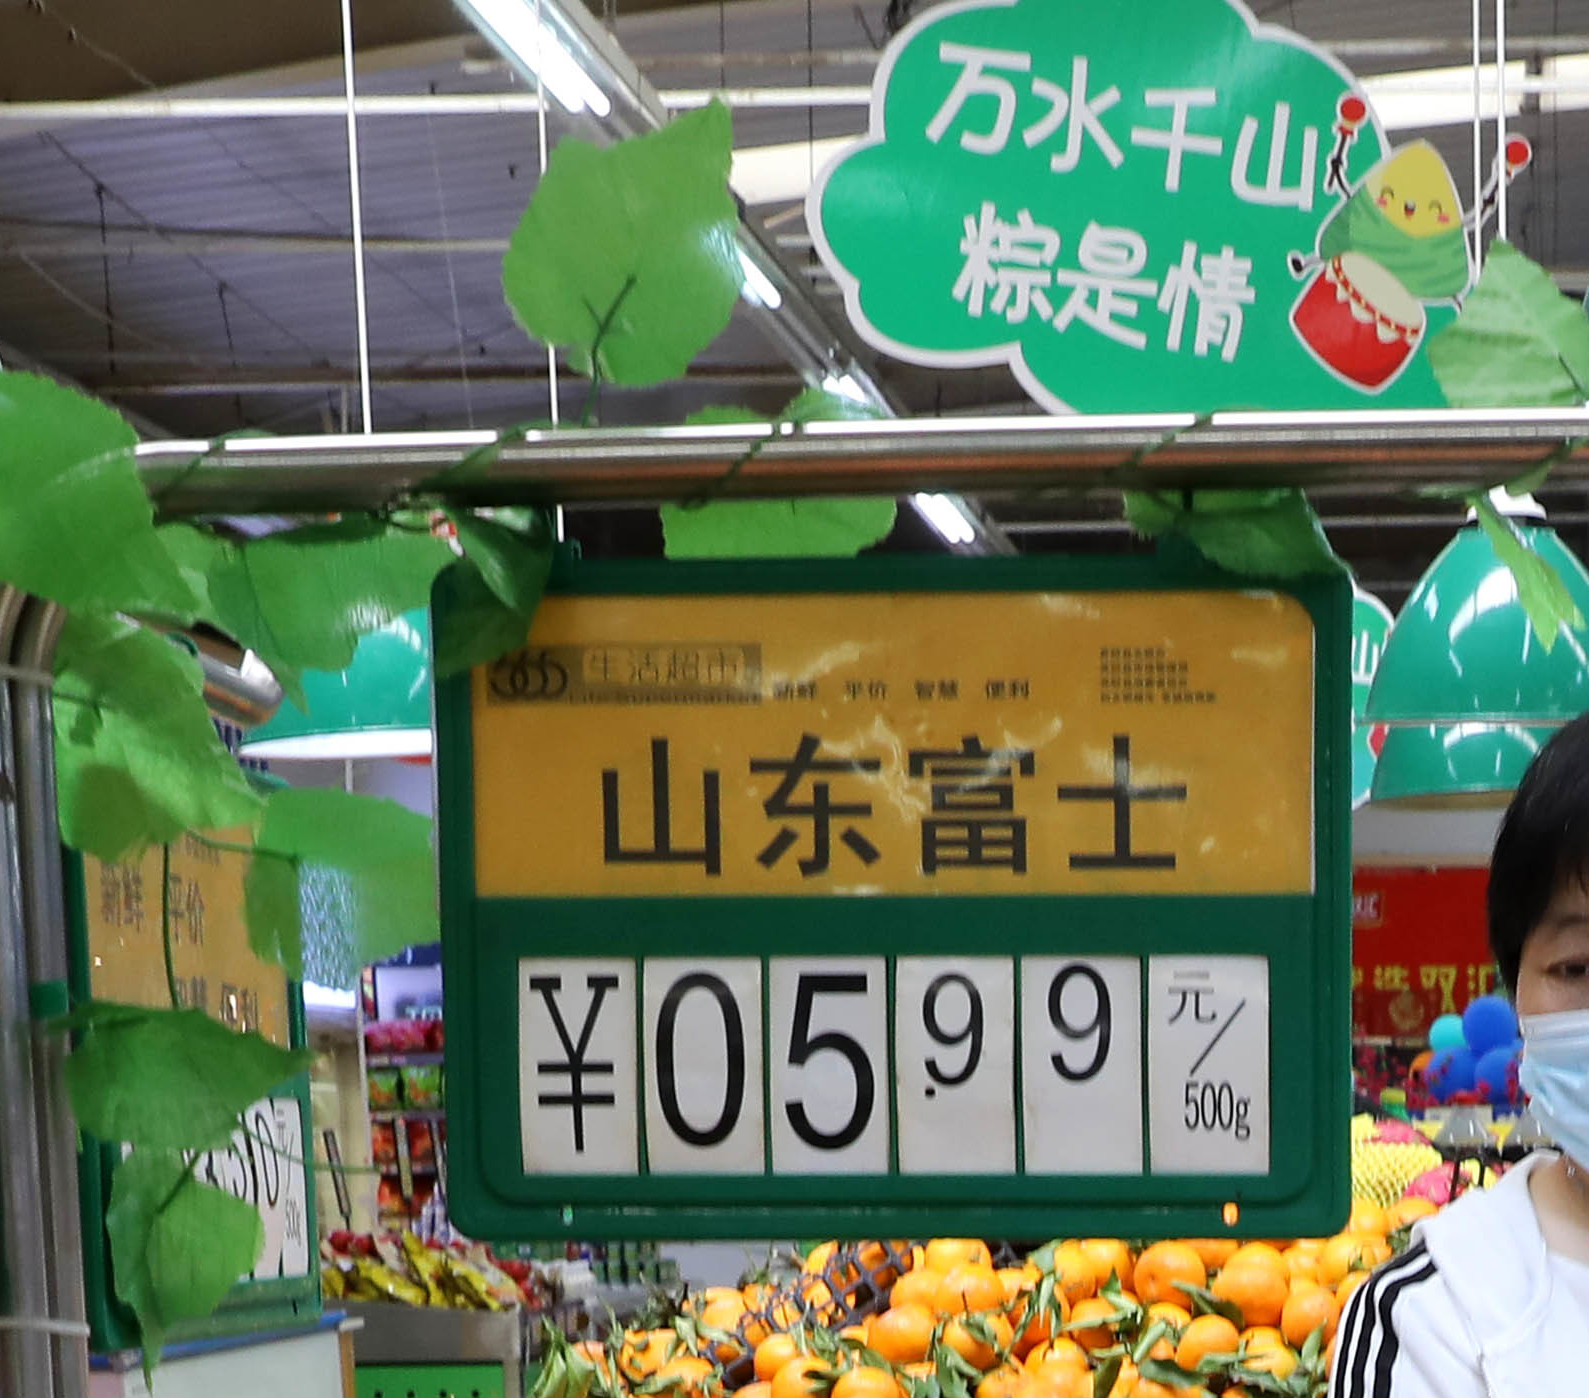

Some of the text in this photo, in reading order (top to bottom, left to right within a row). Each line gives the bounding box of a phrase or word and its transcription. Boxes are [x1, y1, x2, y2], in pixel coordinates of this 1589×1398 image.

[925, 42, 1320, 212] 万水千山
[952, 202, 1256, 363] 粽是情
[601, 734, 1188, 877] 山东富士
